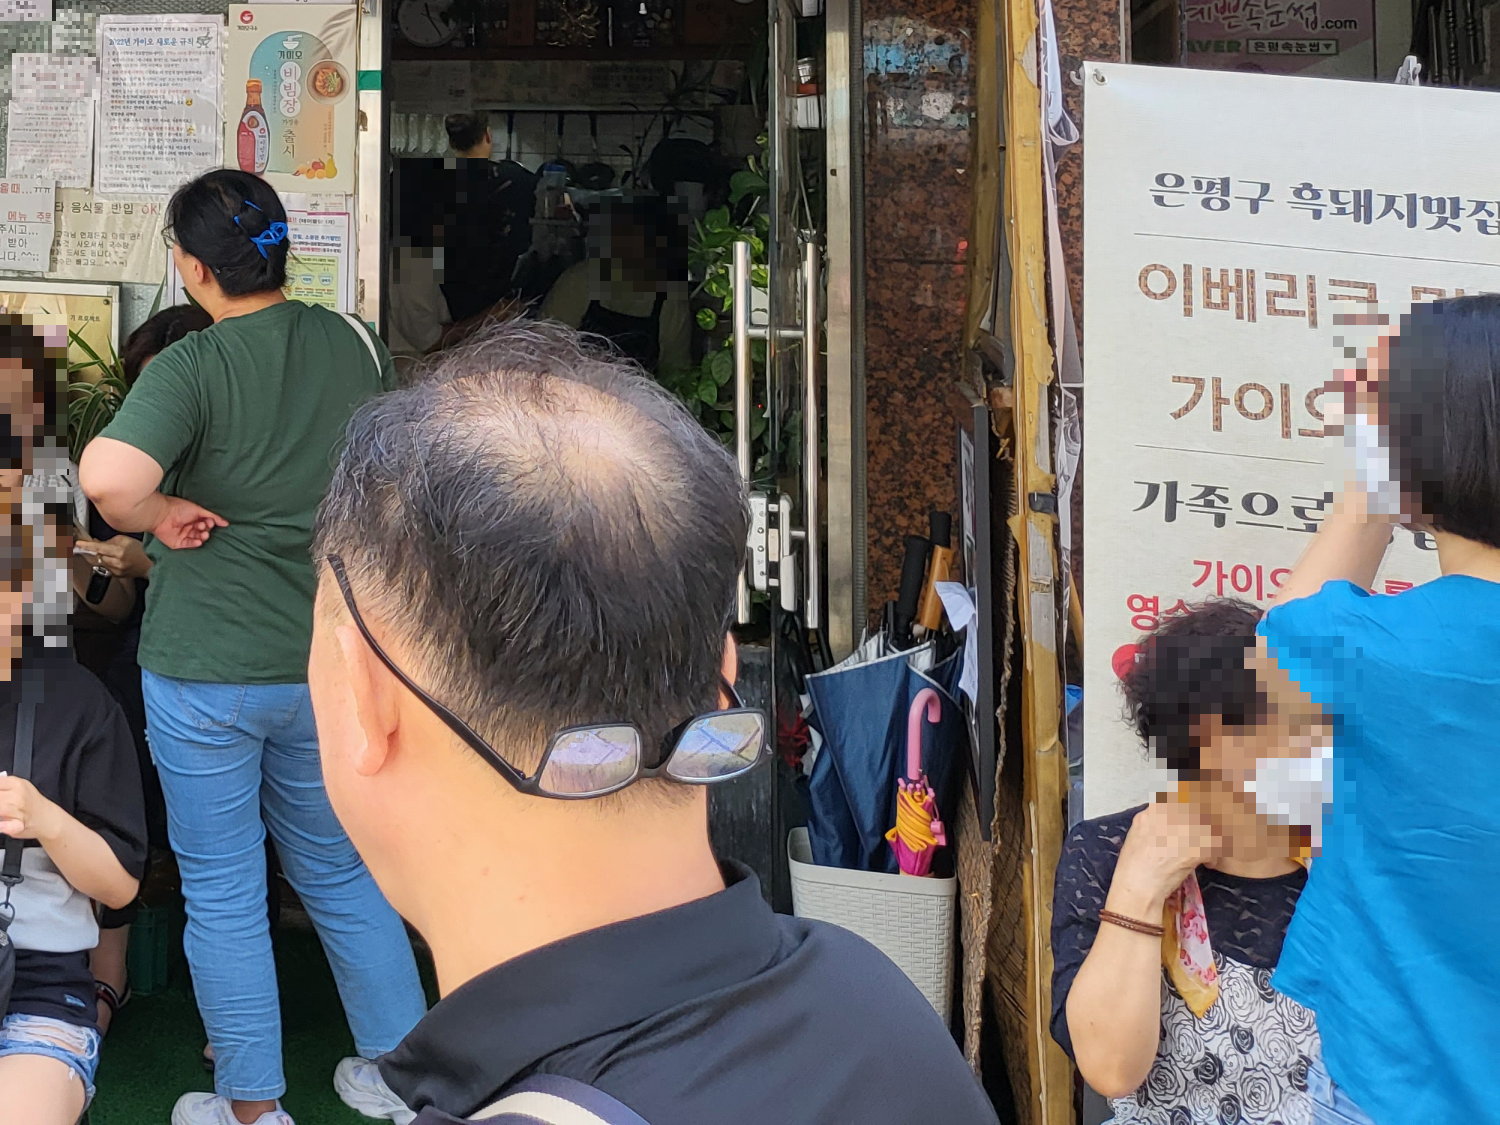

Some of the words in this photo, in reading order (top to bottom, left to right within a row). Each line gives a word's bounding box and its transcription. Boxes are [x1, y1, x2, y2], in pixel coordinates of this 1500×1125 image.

[1254, 40, 1321, 53] 은평속눈썹
[283, 65, 298, 114] 비빔장
[282, 128, 297, 160] 출시
[71, 201, 105, 214] 음식물
[111, 202, 134, 214] 반입
[1148, 172, 1275, 215] 은평구
[1286, 181, 1500, 236] 흑돼지맛집
[7, 210, 28, 222] 메뉴
[8, 237, 28, 249] 받아
